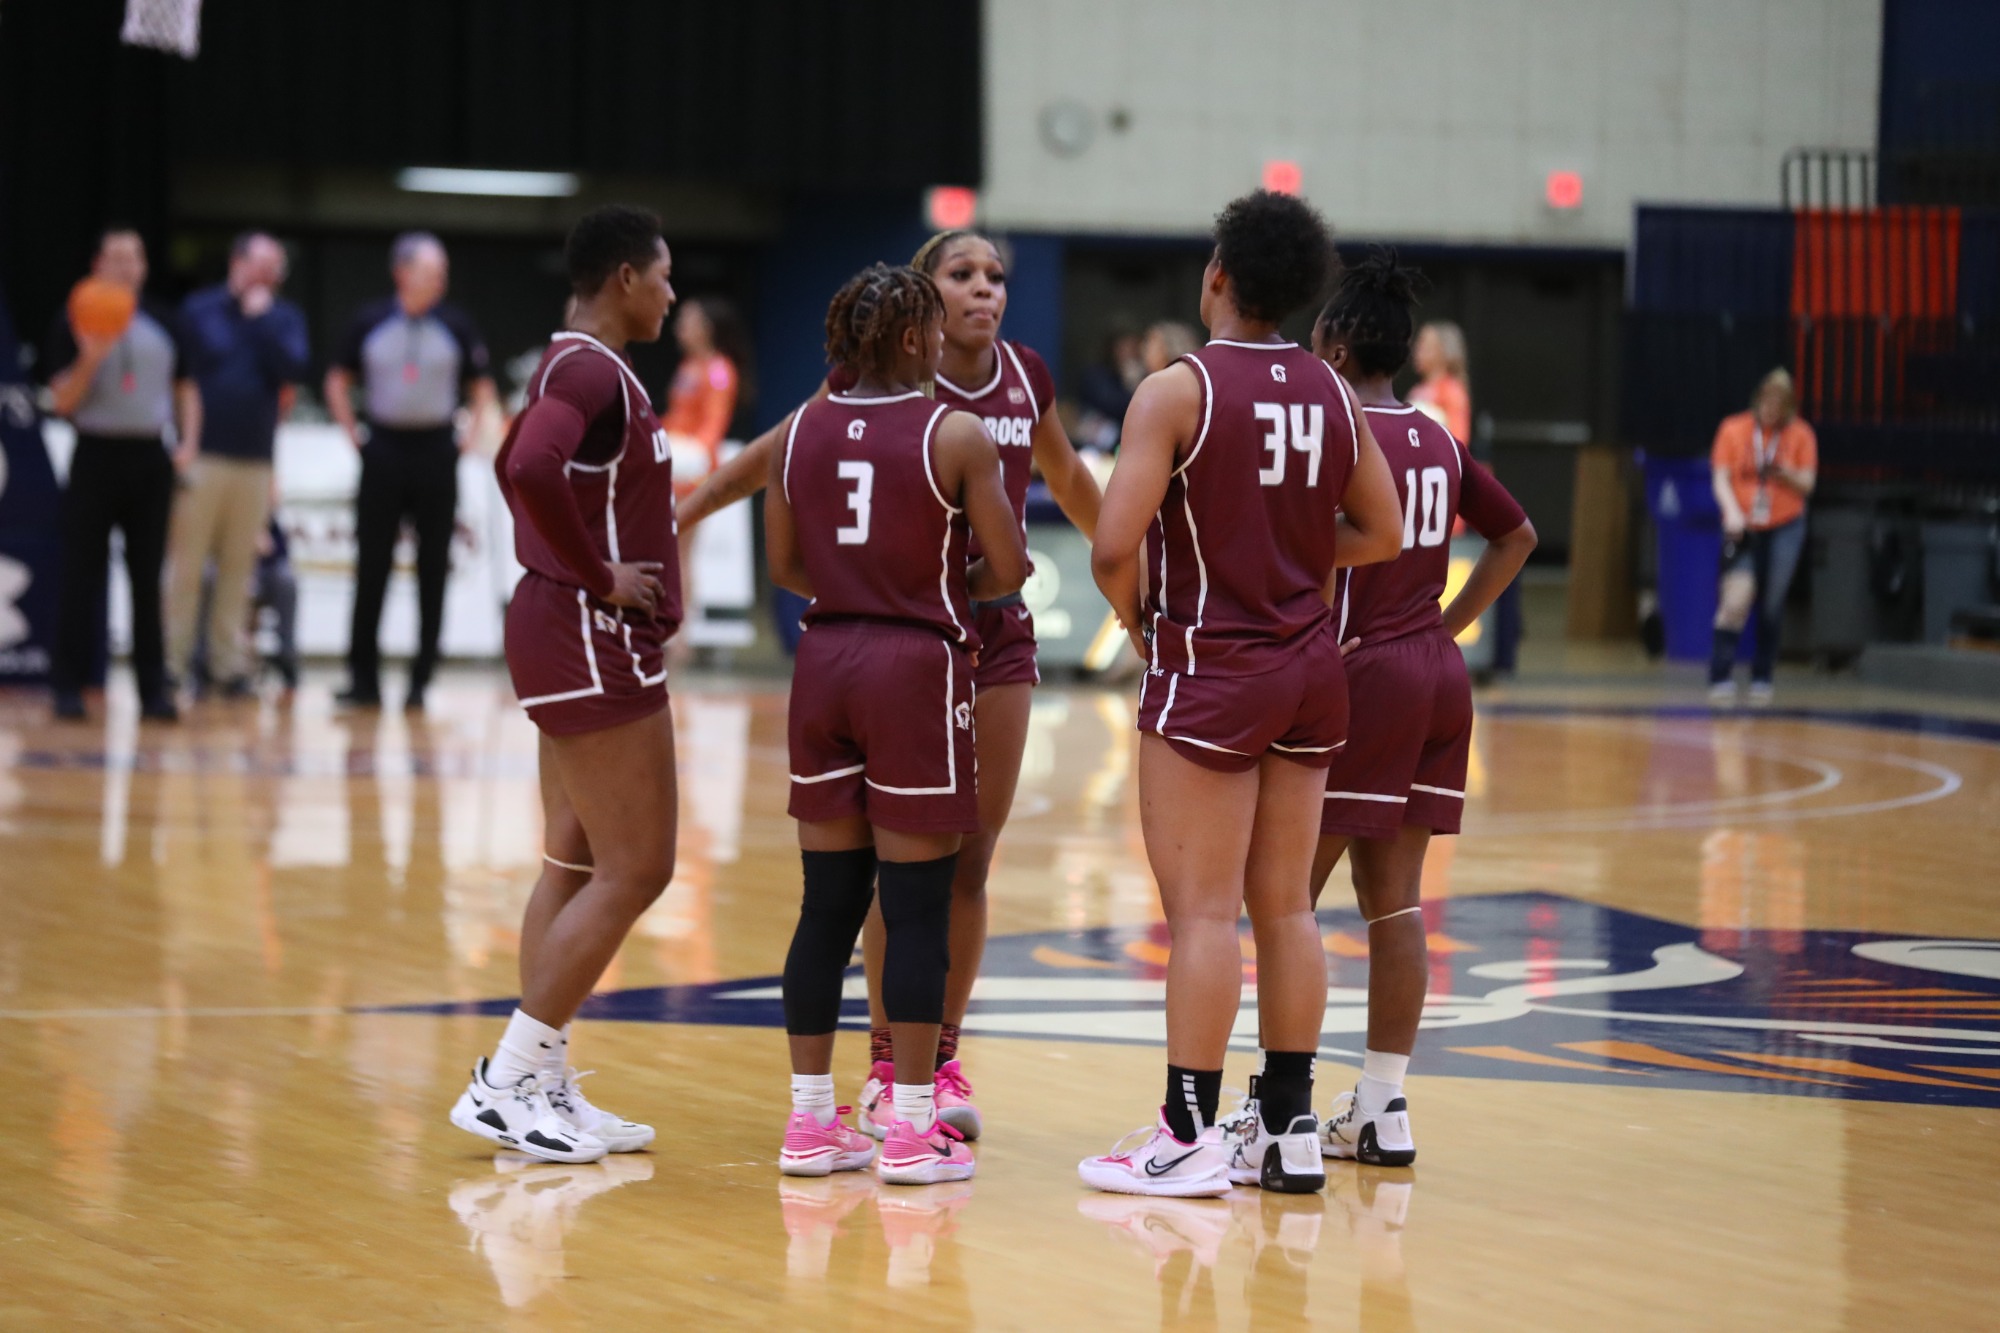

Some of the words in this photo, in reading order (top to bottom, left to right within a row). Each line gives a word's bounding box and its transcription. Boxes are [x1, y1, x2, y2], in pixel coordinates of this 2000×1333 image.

[1253, 402, 1324, 488] 34
[837, 460, 875, 545] 3
[1402, 466, 1448, 550] 10
